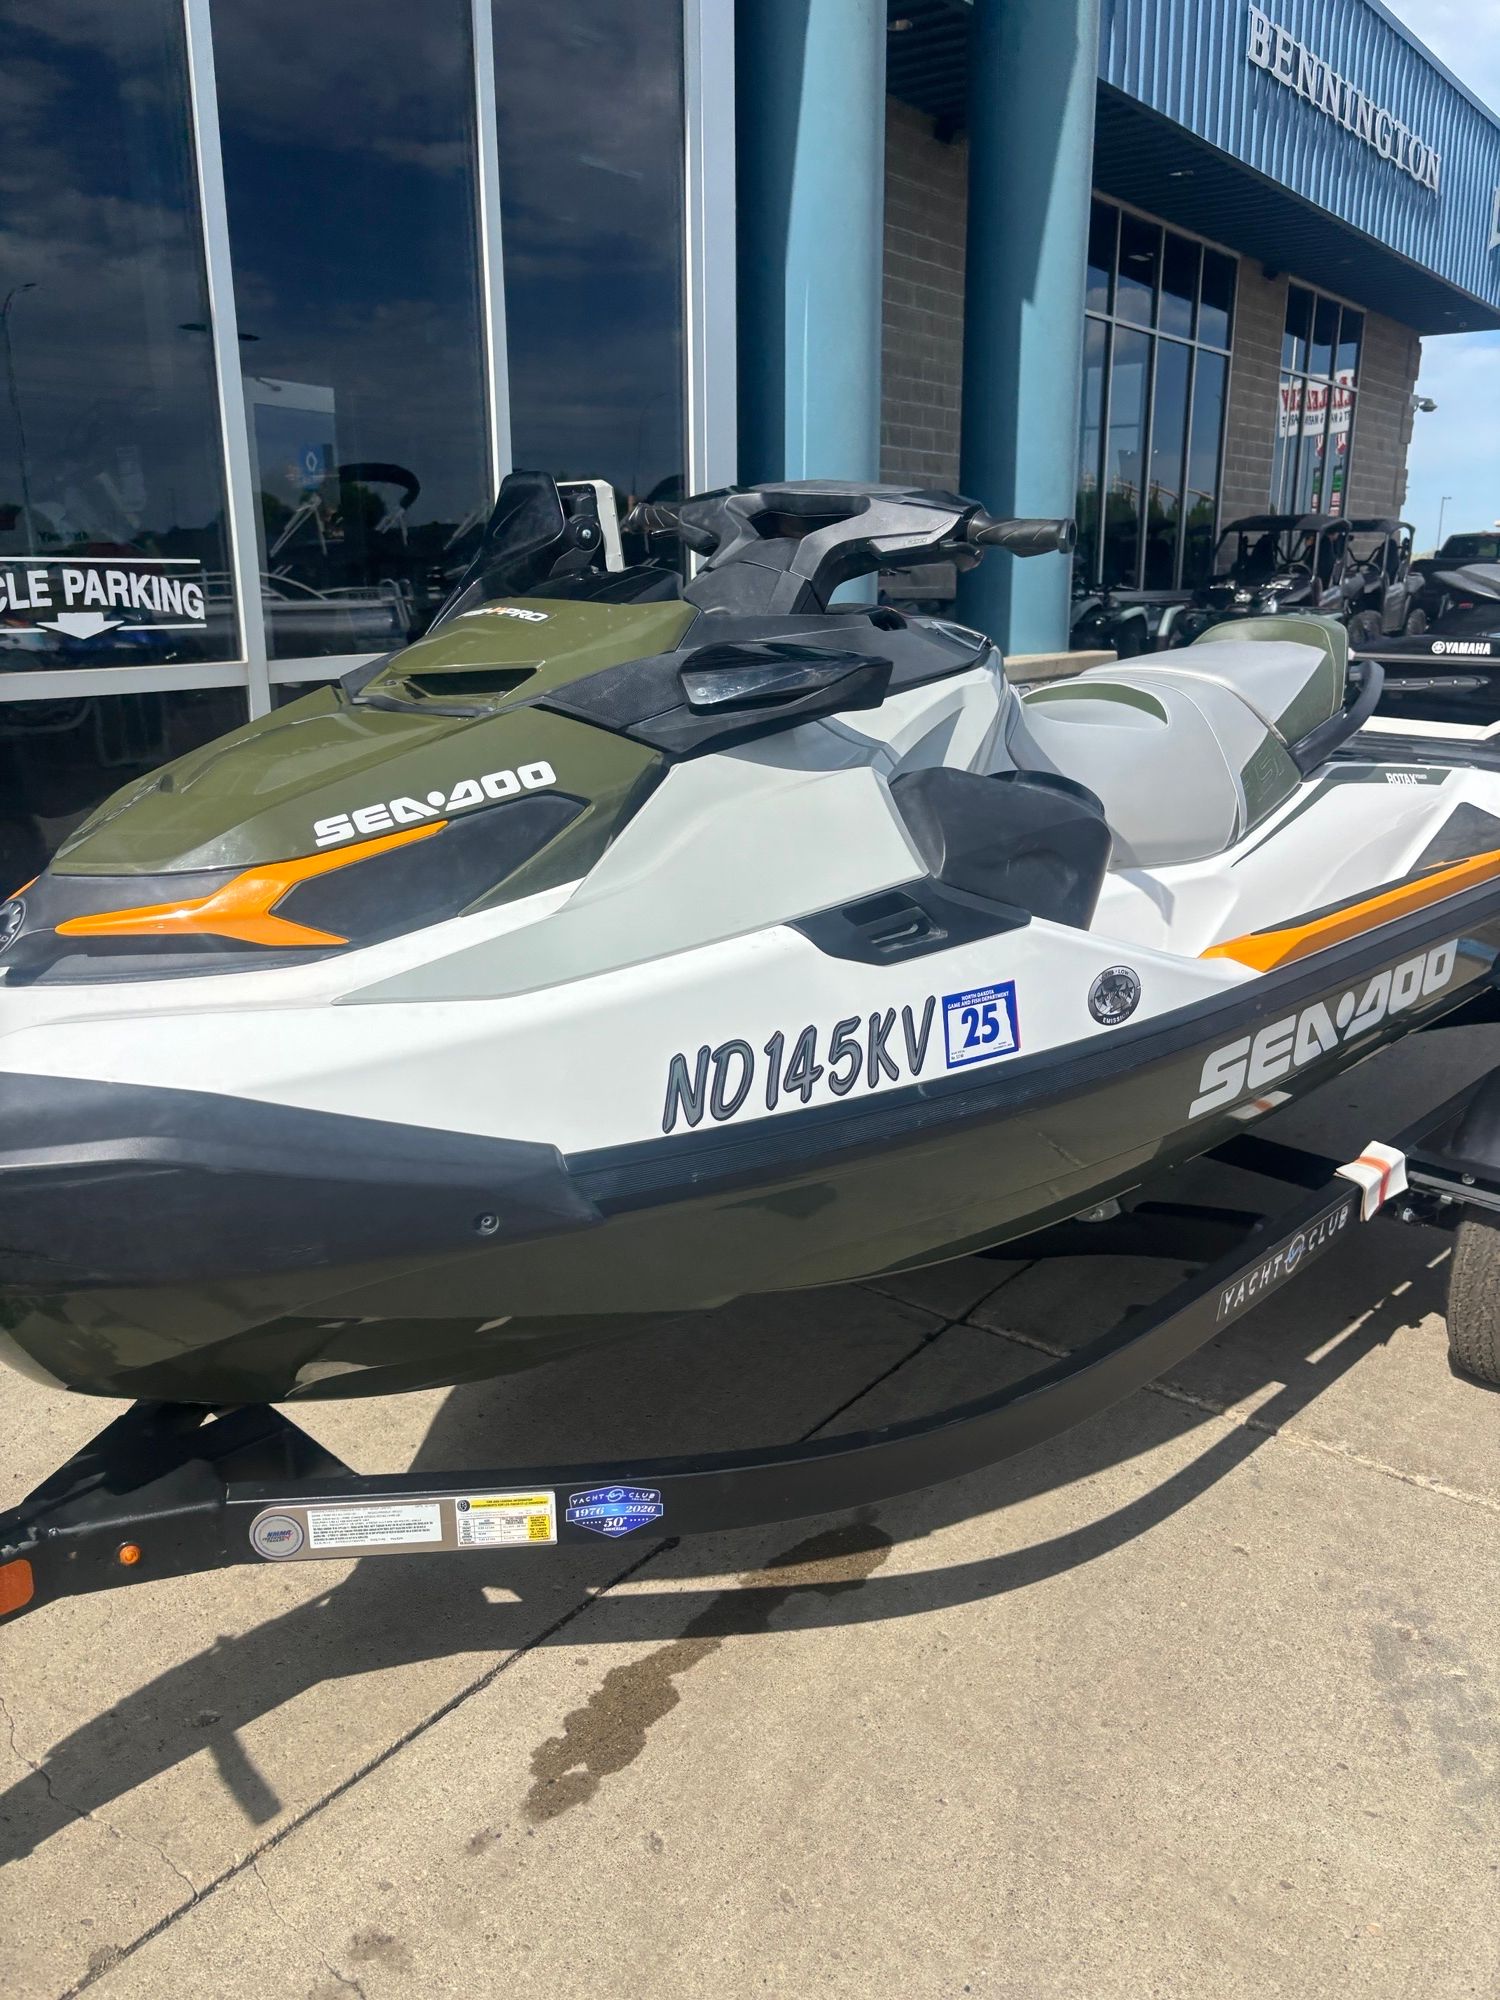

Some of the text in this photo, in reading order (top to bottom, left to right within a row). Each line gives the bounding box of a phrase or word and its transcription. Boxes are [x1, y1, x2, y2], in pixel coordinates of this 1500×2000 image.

[1247, 4, 1441, 198] BENNINGTON
[62, 568, 206, 620] PARKING
[1446, 641, 1491, 655] YAMAHA
[1385, 772, 1418, 785] ROTAX
[947, 1002, 961, 1010] GAME
[981, 991, 1009, 1003] DEPARTMENT
[961, 989, 994, 1001] NORTH DAKOTA
[961, 1002, 1000, 1049] 25
[1223, 1205, 1350, 1315] YACHT CLUB
[572, 1491, 656, 1505] YACHT CLUB
[574, 1506, 606, 1518] 1976
[625, 1505, 656, 1514] 2026
[603, 1516, 628, 1528] 50
